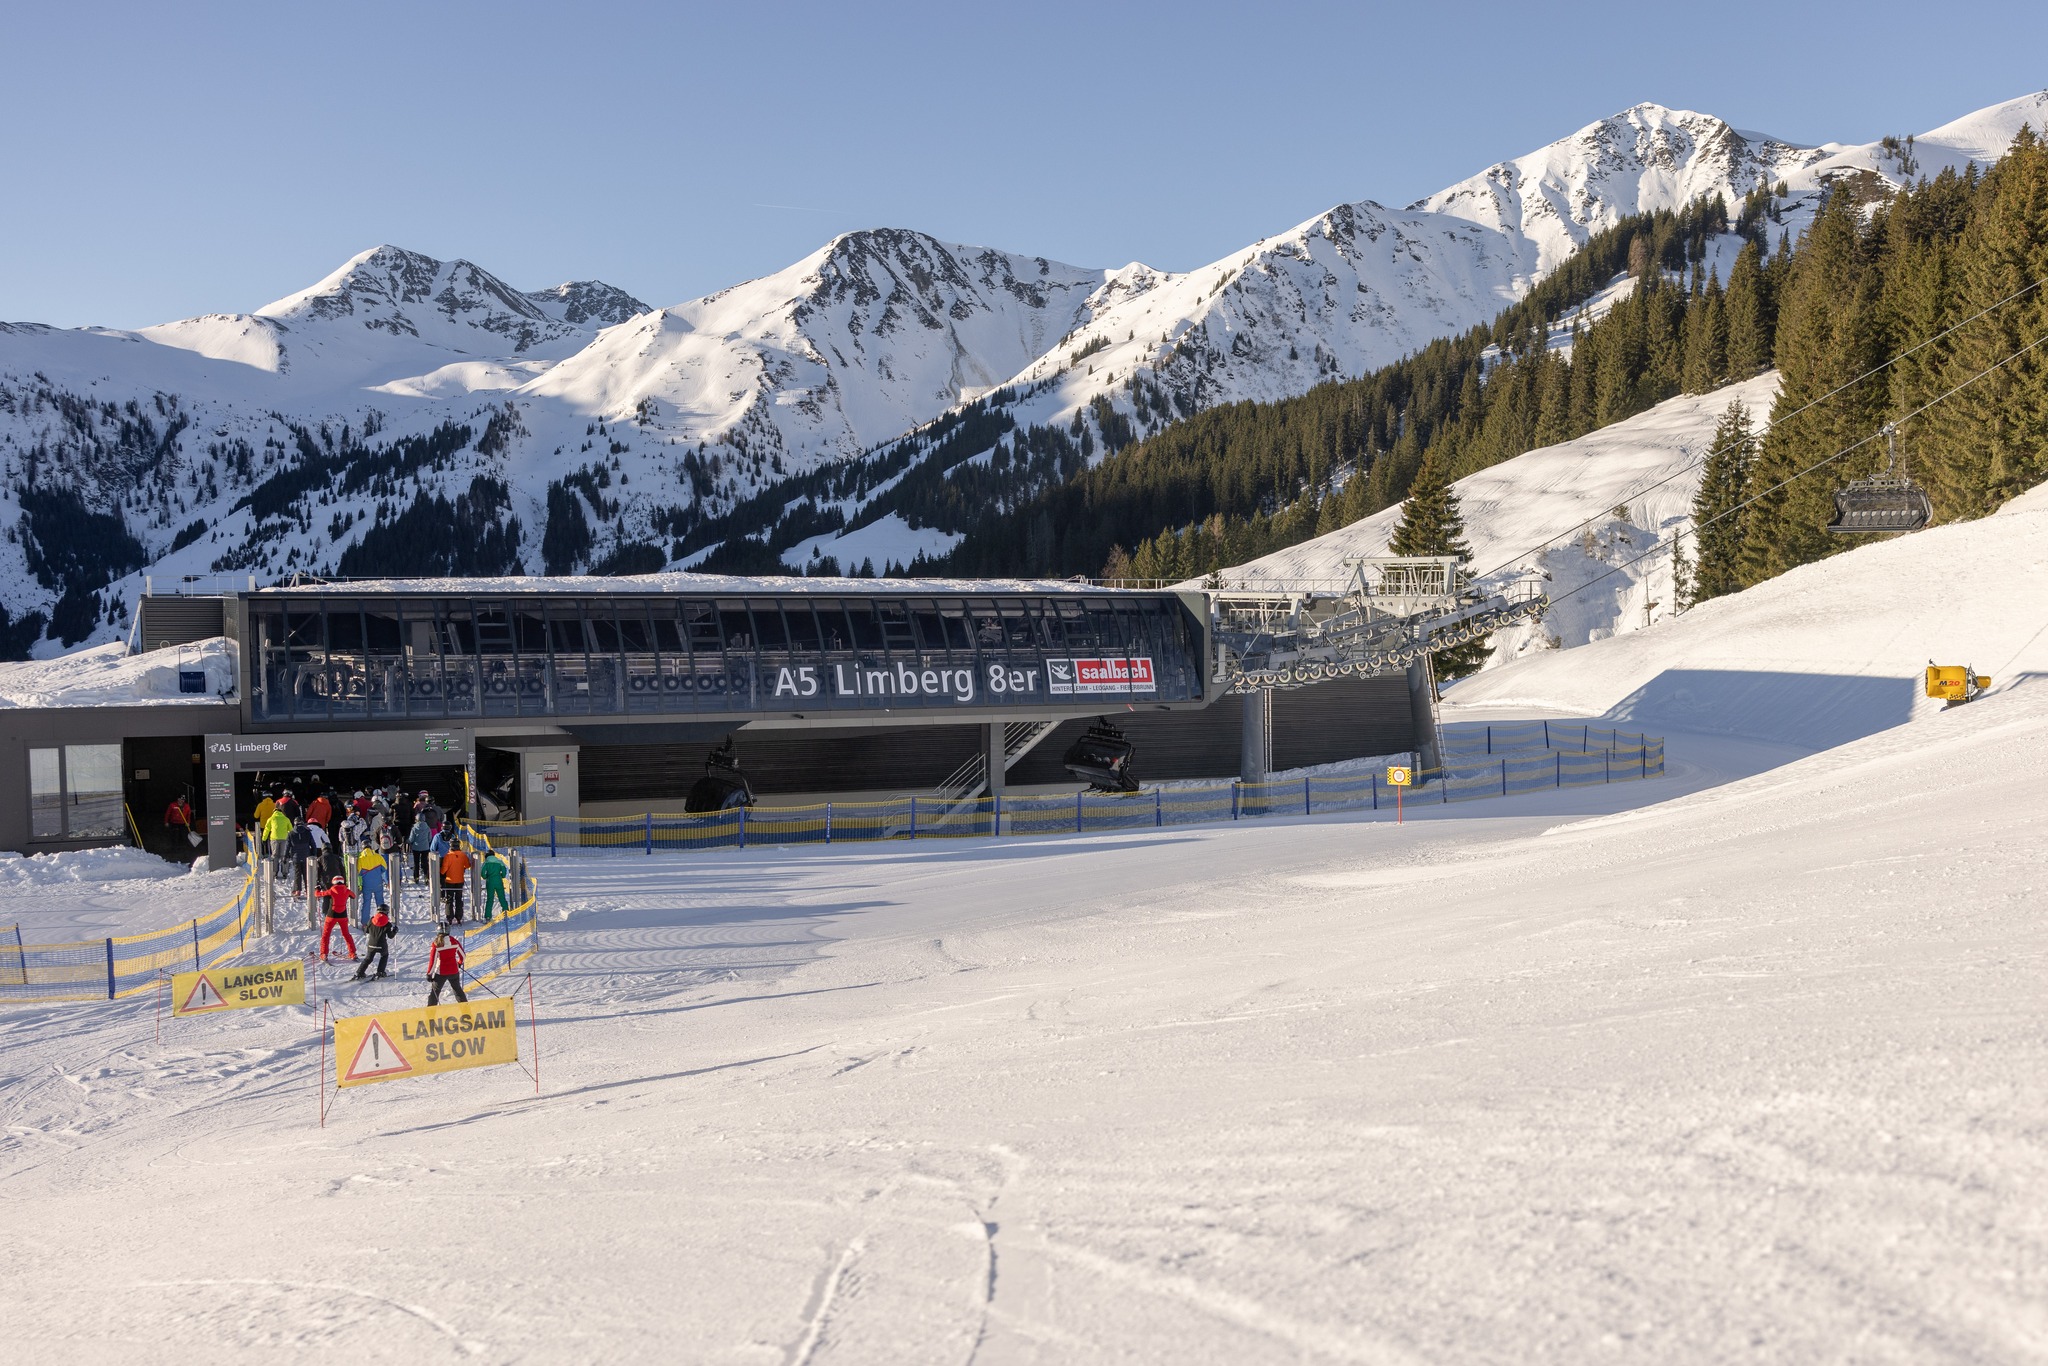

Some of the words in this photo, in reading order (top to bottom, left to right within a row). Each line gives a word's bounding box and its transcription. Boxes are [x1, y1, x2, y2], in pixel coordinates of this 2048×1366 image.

[1081, 660, 1148, 680] saalbach
[775, 667, 817, 697] A5
[836, 662, 974, 701] Limberg
[989, 664, 1037, 692] 8er
[219, 744, 231, 752] A5
[235, 743, 270, 753] Limberg
[273, 742, 287, 751] 8er
[224, 968, 297, 989] LANGSAM
[240, 985, 283, 1001] SLOW
[402, 1010, 506, 1041] LANGSAM
[426, 1036, 486, 1062] SLOW
